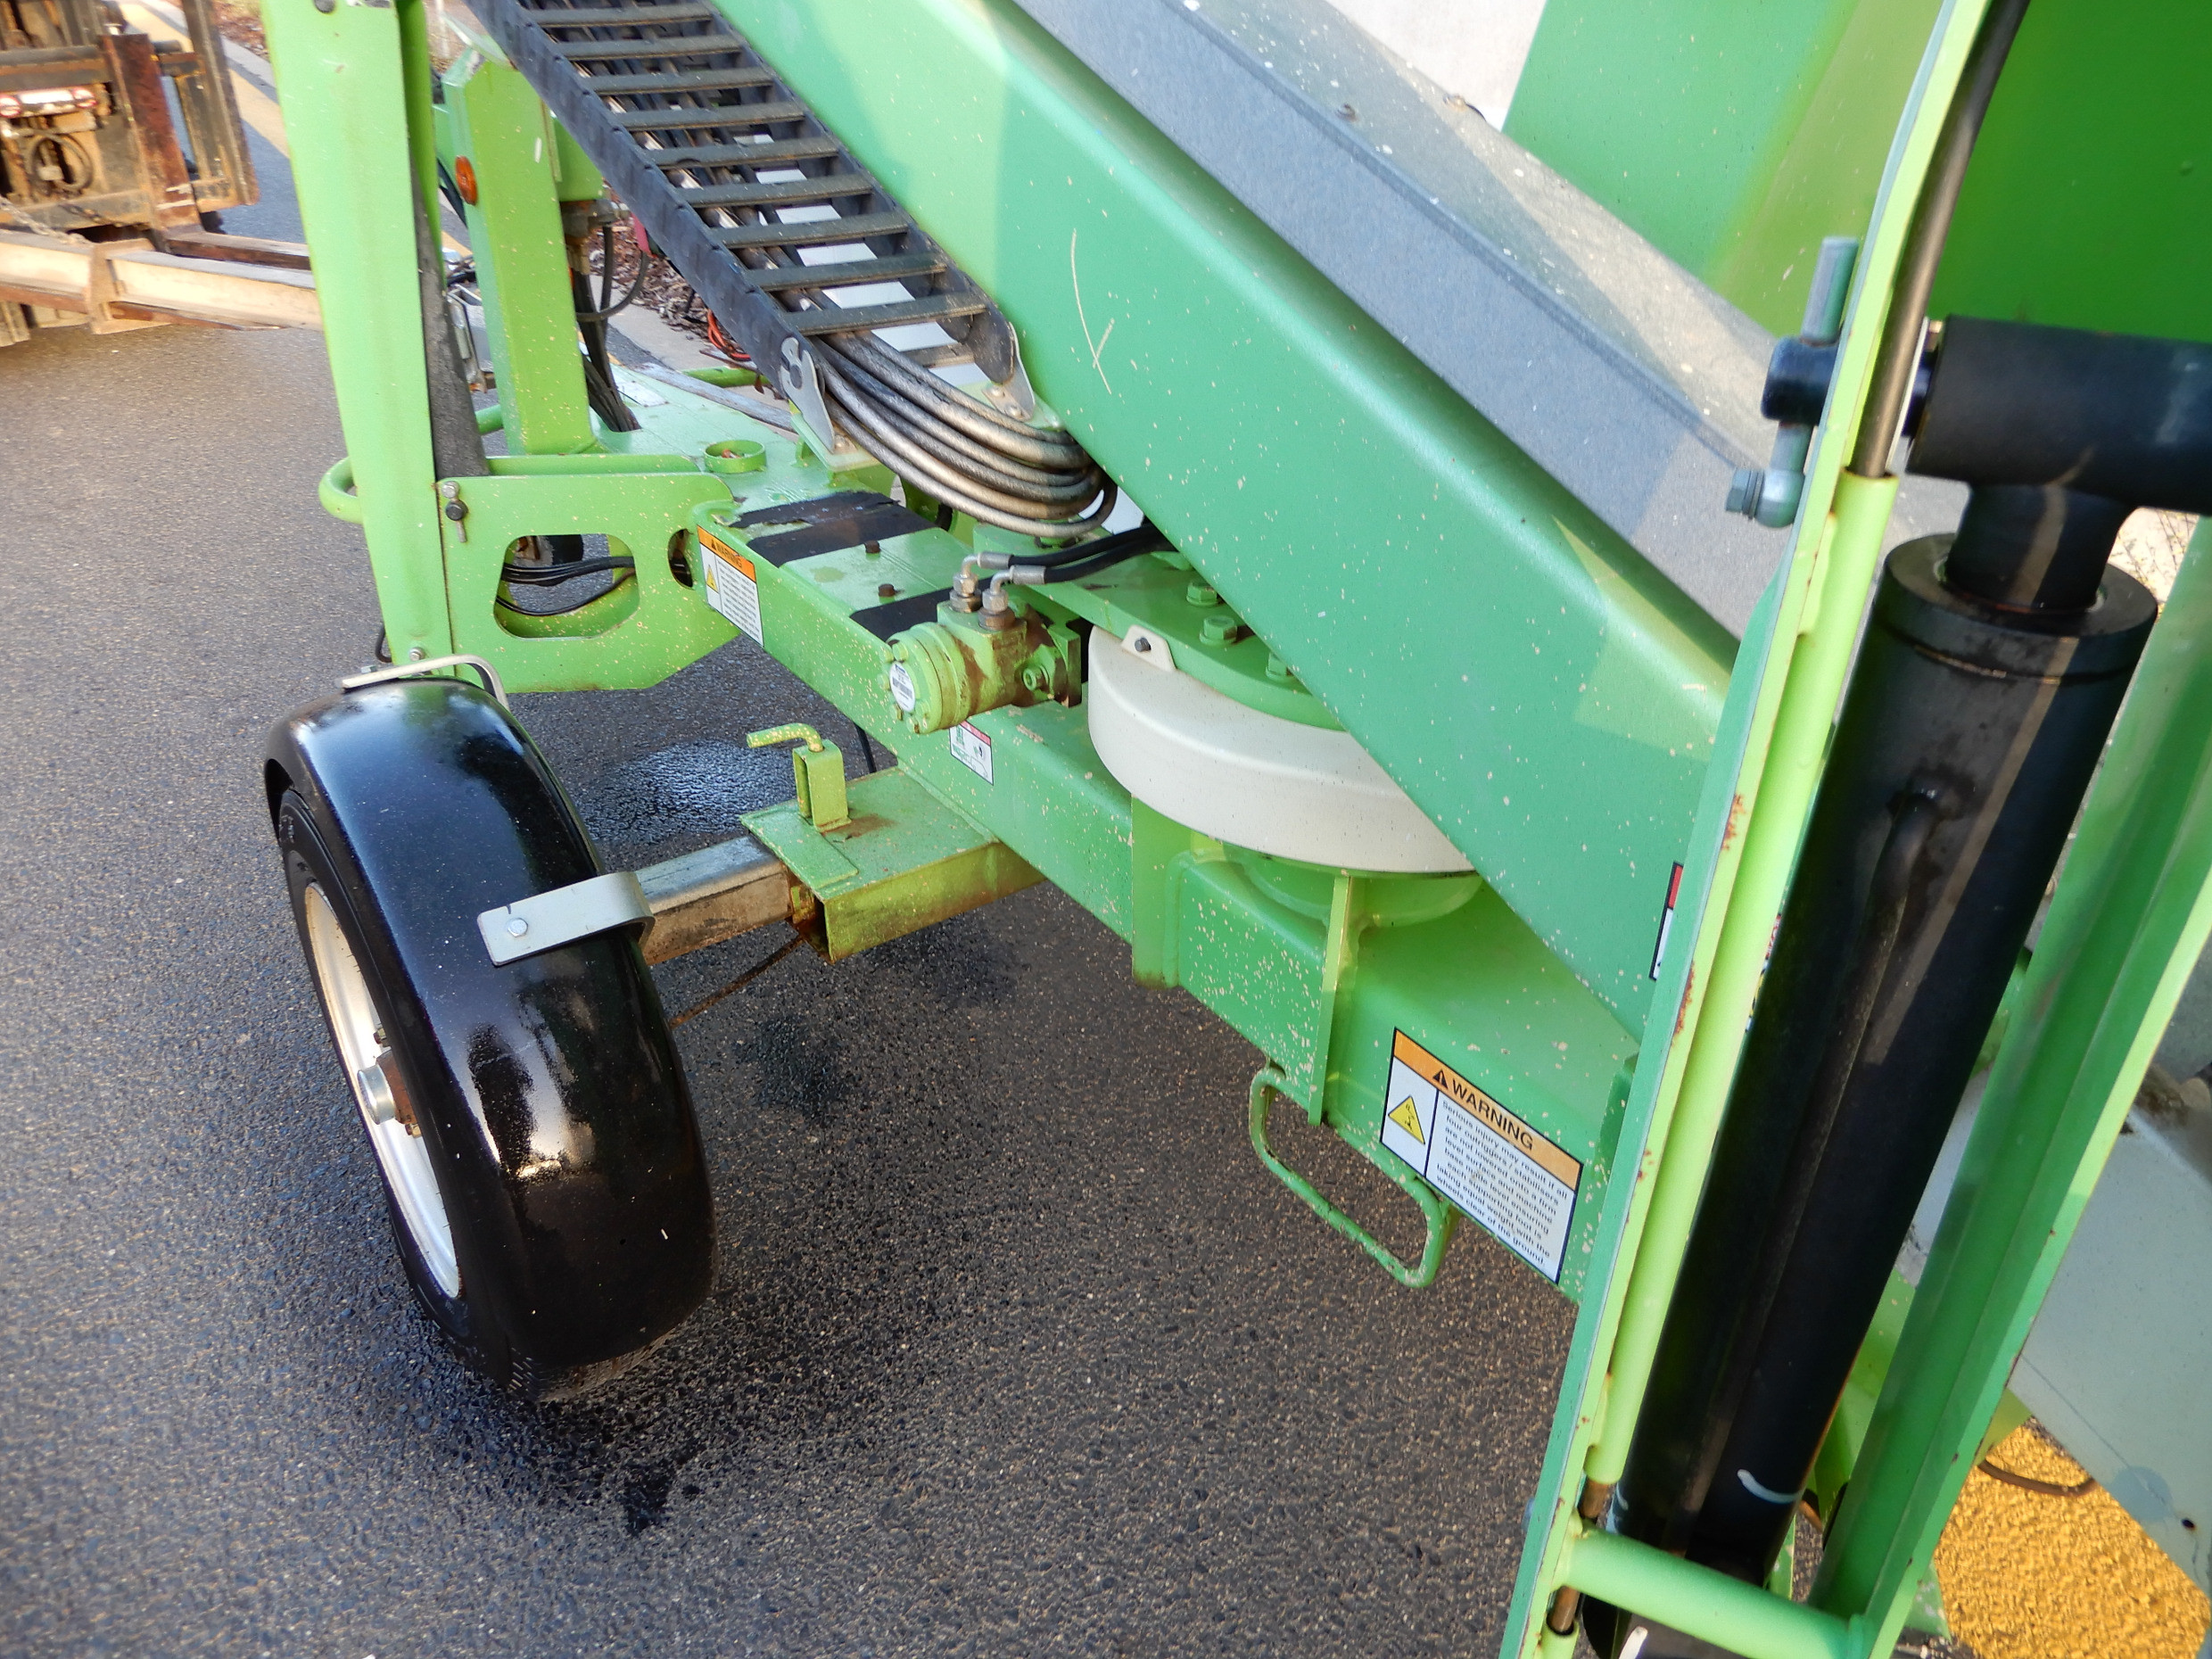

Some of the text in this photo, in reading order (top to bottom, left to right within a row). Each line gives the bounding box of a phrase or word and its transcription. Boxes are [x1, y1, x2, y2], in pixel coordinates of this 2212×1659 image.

[1442, 1101, 1473, 1129] Serious
[1474, 1125, 1499, 1149] injury
[1500, 1145, 1519, 1164] may
[1520, 1160, 1546, 1184] result
[1556, 1187, 1567, 1201] all
[1451, 1077, 1533, 1151] WARNING
[1443, 1146, 1464, 1167] base
[1489, 1182, 1509, 1202] level
[1510, 1200, 1549, 1236] ensuring
[1444, 1126, 1457, 1140] are
[1458, 1136, 1473, 1152] not
[1474, 1147, 1508, 1179] lowered
[1508, 1176, 1530, 1195] onto
[1538, 1196, 1556, 1216] firm
[1444, 1135, 1553, 1225] level surface and machine
[1445, 1113, 1462, 1132] four
[1464, 1129, 1507, 1167] outriggers
[1513, 1167, 1559, 1206] stabilisers
[1446, 1160, 1466, 1181] each
[1467, 1177, 1513, 1218] supporting
[1515, 1213, 1532, 1233] foot
[1436, 1174, 1464, 1201] wheels
[1465, 1198, 1485, 1217] clear
[1497, 1222, 1511, 1237] the
[1436, 1162, 1550, 1259] taking equal weight with the
